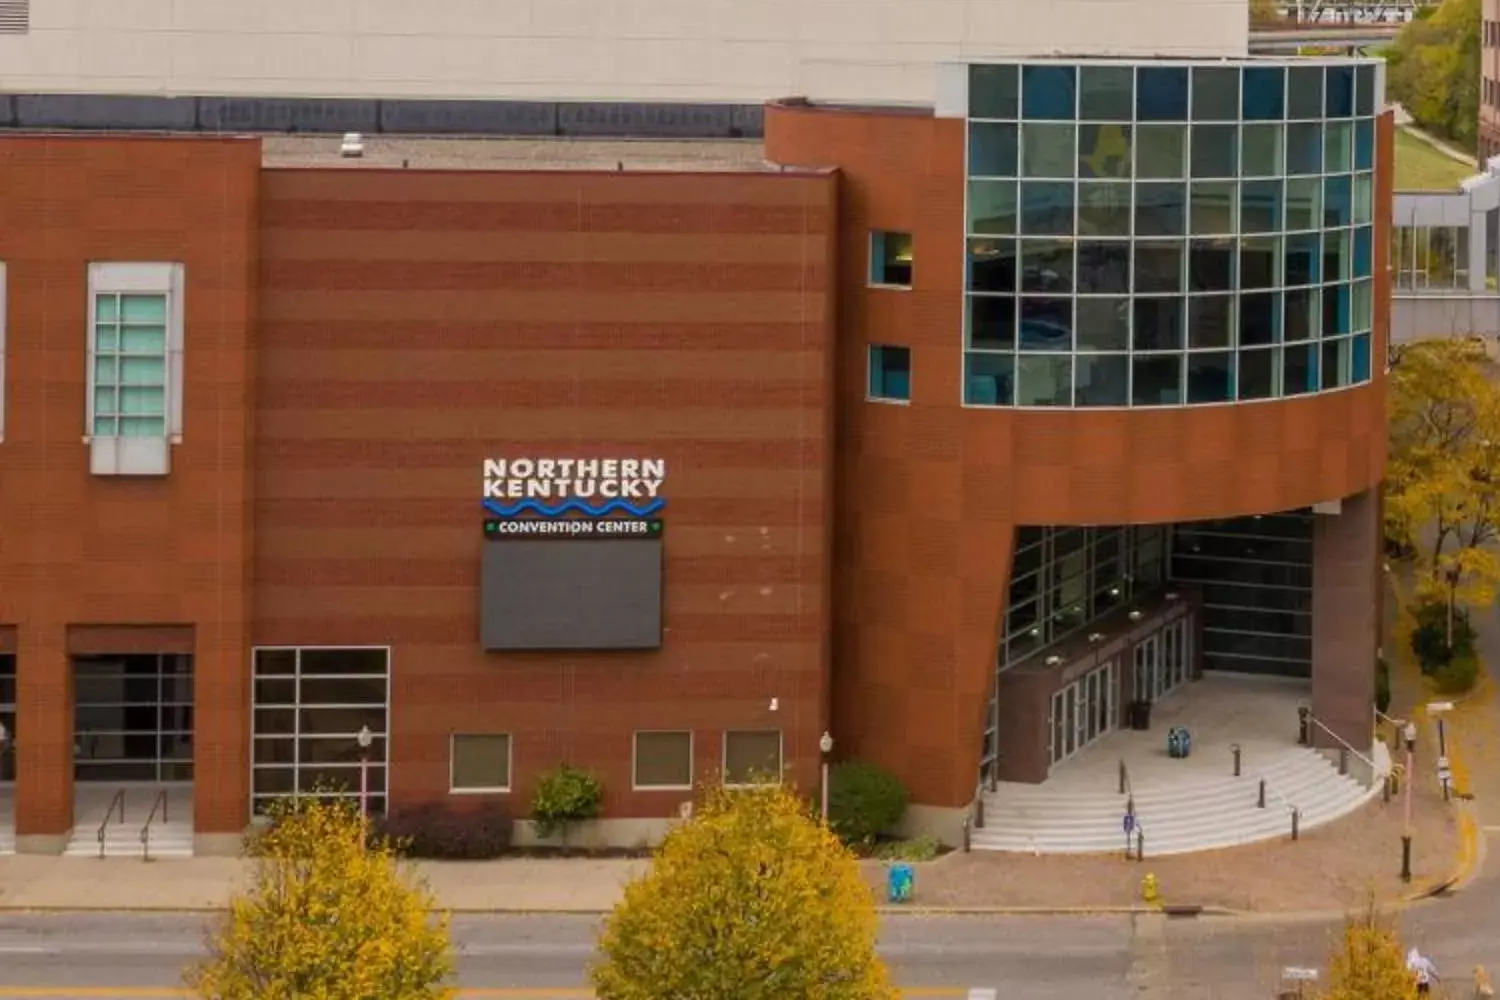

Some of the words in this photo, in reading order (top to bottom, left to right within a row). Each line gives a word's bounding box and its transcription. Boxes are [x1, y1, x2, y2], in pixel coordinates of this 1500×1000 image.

[483, 459, 665, 478] NORTHERN
[483, 479, 663, 497] KENTUCKY
[500, 522, 593, 535] CONVENTION
[597, 521, 648, 533] CENTER
